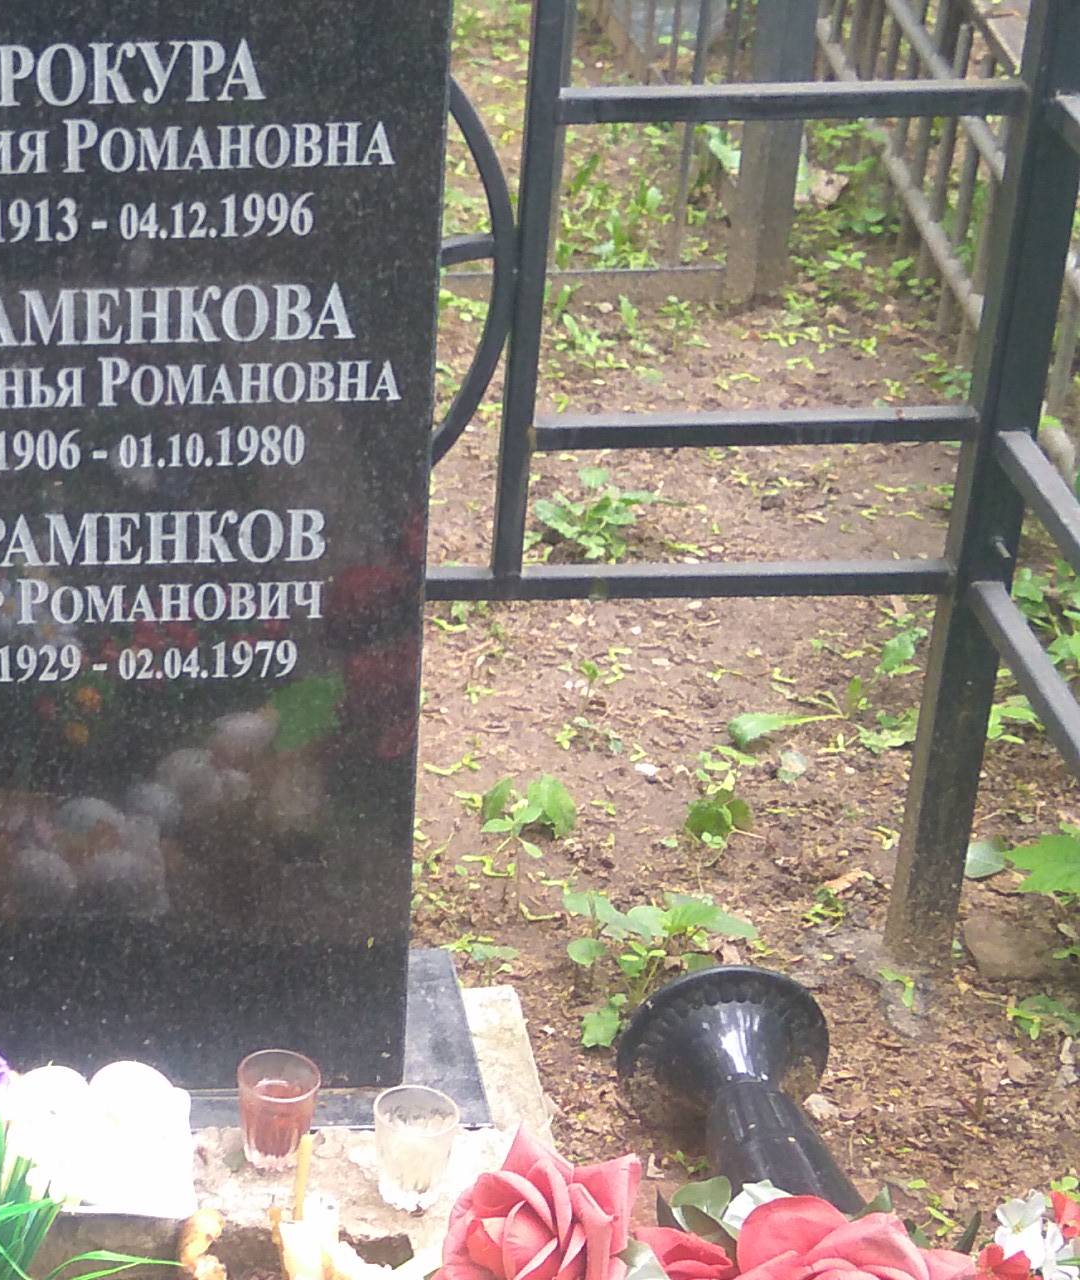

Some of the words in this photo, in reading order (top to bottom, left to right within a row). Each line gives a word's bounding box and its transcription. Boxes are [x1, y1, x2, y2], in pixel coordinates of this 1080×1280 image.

[62, 118, 396, 174] РОМАНОВНА
[119, 191, 315, 240] 04.12.1996
[97, 356, 402, 408] РОМАНОВНА
[118, 424, 306, 469] 01.10.1980
[15, 577, 325, 625] РОМАНОВИЧ
[118, 639, 299, 681] 02.04.1979
